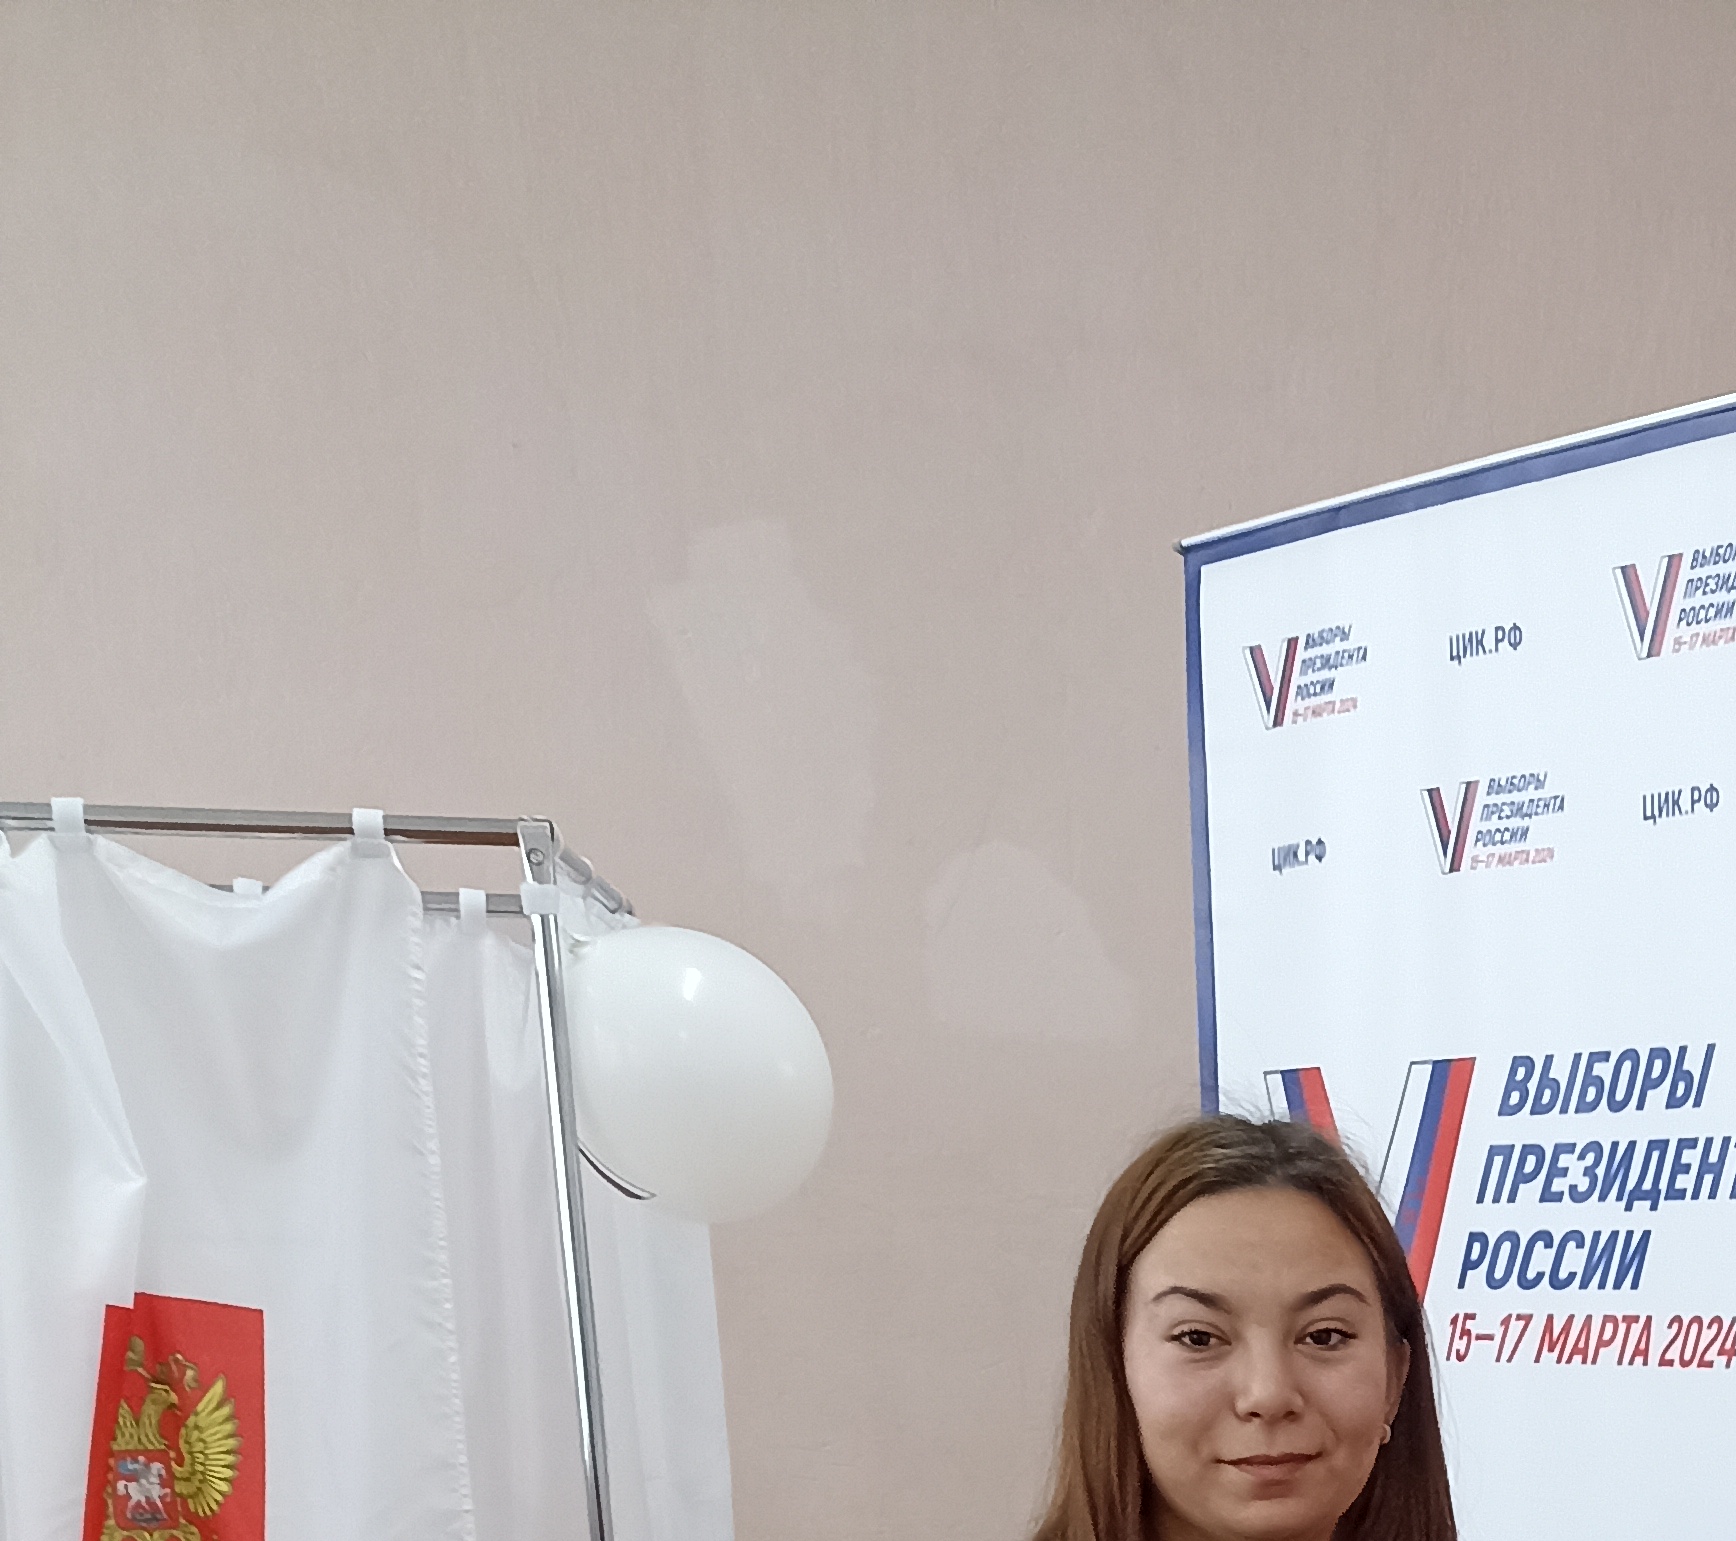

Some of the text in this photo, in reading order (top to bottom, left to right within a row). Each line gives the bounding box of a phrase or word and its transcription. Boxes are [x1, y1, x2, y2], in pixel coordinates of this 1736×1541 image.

[1676, 598, 1736, 630] РОССИИ
[1449, 622, 1522, 666] ЦИК.РФ
[1486, 771, 1547, 796] ВЫБОРЫ
[1480, 794, 1565, 822] ПРЕЗИДЕНТА
[1643, 783, 1720, 826] ЦИК.РФ
[1474, 825, 1530, 848] РОССИИ
[1272, 838, 1326, 876] ЦИК.РФ
[1498, 1044, 1716, 1117] ВЫБОРЫ
[1457, 1230, 1651, 1290] РОССИИ
[1446, 1313, 1533, 1363] 15–17
[1534, 1314, 1652, 1366] МАРТА
